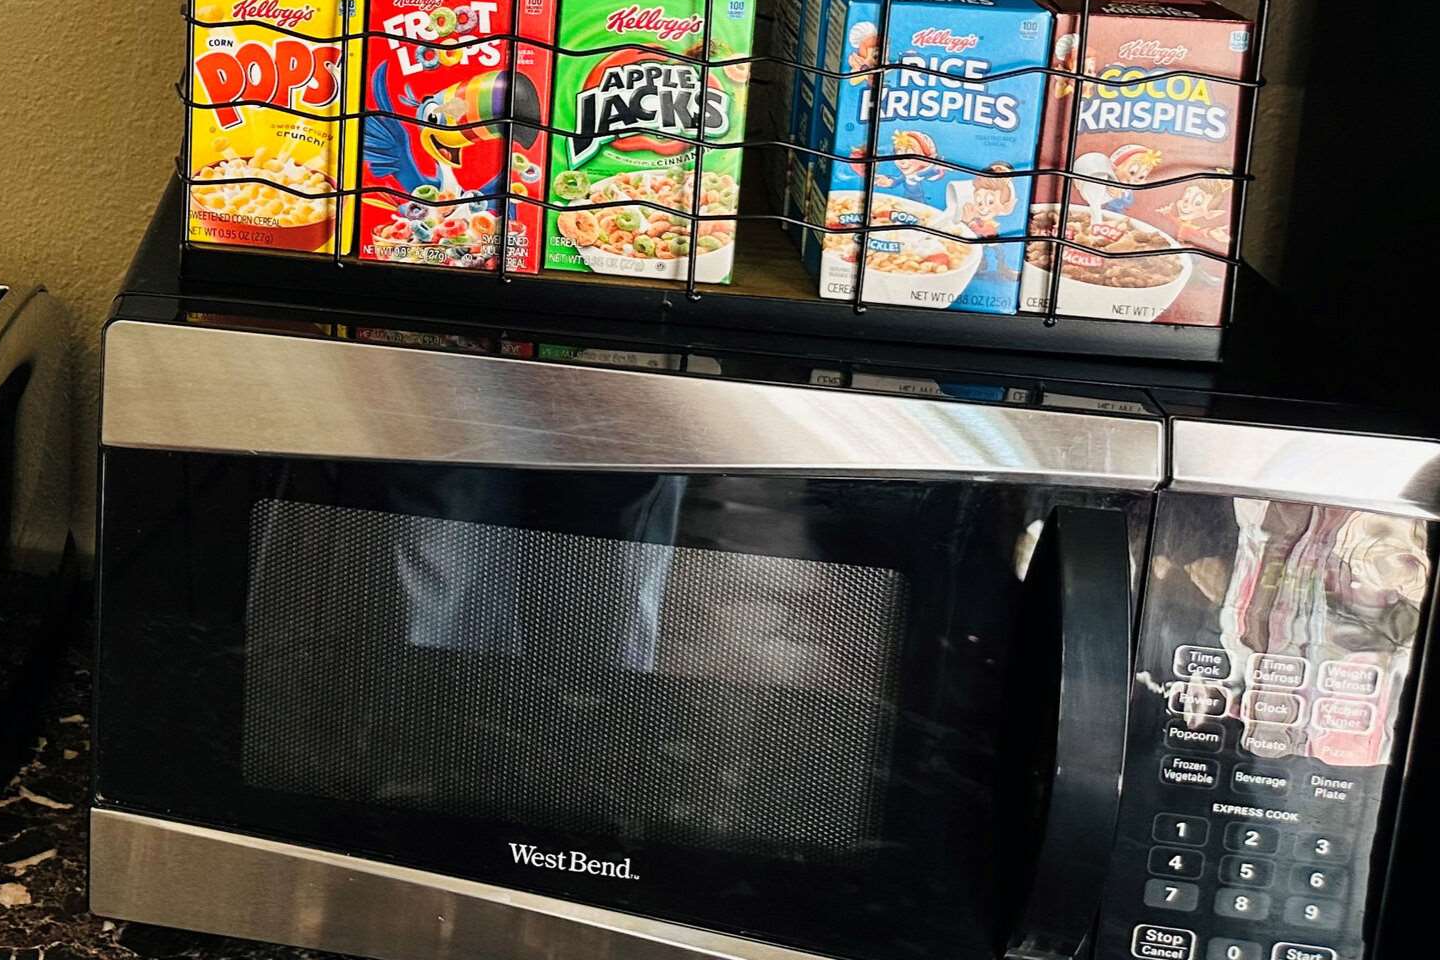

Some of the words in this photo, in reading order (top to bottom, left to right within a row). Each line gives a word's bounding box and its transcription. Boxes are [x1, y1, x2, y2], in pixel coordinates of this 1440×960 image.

[383, 1, 498, 50] FROOT
[607, 5, 703, 39] Kellogg's
[208, 38, 234, 48] CORN
[912, 28, 978, 52] Kellogg's
[397, 35, 501, 76] LOOPS
[1119, 39, 1188, 64] Kellogg's
[601, 65, 697, 92] APPLE
[900, 56, 990, 92] RICE
[195, 40, 342, 129] POPS
[1097, 68, 1212, 106] COCOA
[859, 88, 1018, 130] KRISPIES
[574, 84, 723, 157] JACKS
[1077, 98, 1226, 140] KRISPIES
[231, 214, 253, 226] CORN
[253, 216, 281, 228] CEREAL
[839, 213, 864, 225] SNA
[204, 227, 218, 237] WT
[481, 234, 529, 246] SWEENED
[853, 233, 900, 252] CCKLE!
[827, 282, 855, 295] CEREA
[910, 290, 930, 301] NET
[931, 291, 947, 302] WT
[971, 294, 986, 306] OZ
[1026, 297, 1052, 309] CERE
[1112, 304, 1131, 316] NET
[1132, 305, 1148, 317] WT
[1189, 650, 1222, 664] Time
[1187, 662, 1220, 676] Cook
[1261, 659, 1295, 672] Time
[1254, 669, 1300, 683] Defrost
[1255, 701, 1288, 714] Clock
[1169, 727, 1219, 742] Popcorn
[1246, 737, 1287, 751] Potato
[1172, 758, 1207, 772] Frozen
[1163, 768, 1214, 785] Vegetable
[1235, 771, 1287, 788] Beverage
[1311, 775, 1354, 790] Dinner
[1314, 787, 1347, 801] Plate
[1212, 803, 1264, 818] EXPRESS
[1265, 809, 1300, 822] COOK
[1176, 822, 1187, 838] 1
[1244, 830, 1260, 847] 2
[1315, 839, 1330, 855] 3
[508, 842, 567, 871] West
[568, 850, 631, 879] Bend
[1168, 855, 1183, 870] 4
[1239, 863, 1255, 879] 5
[1310, 872, 1325, 888] 6
[1165, 887, 1178, 902] 7
[1234, 896, 1249, 912] 8
[1304, 904, 1319, 920] 9
[1145, 929, 1184, 946] Stop
[1140, 944, 1184, 960] Cancel
[1227, 945, 1241, 960] 0
[1286, 948, 1323, 960] Start
